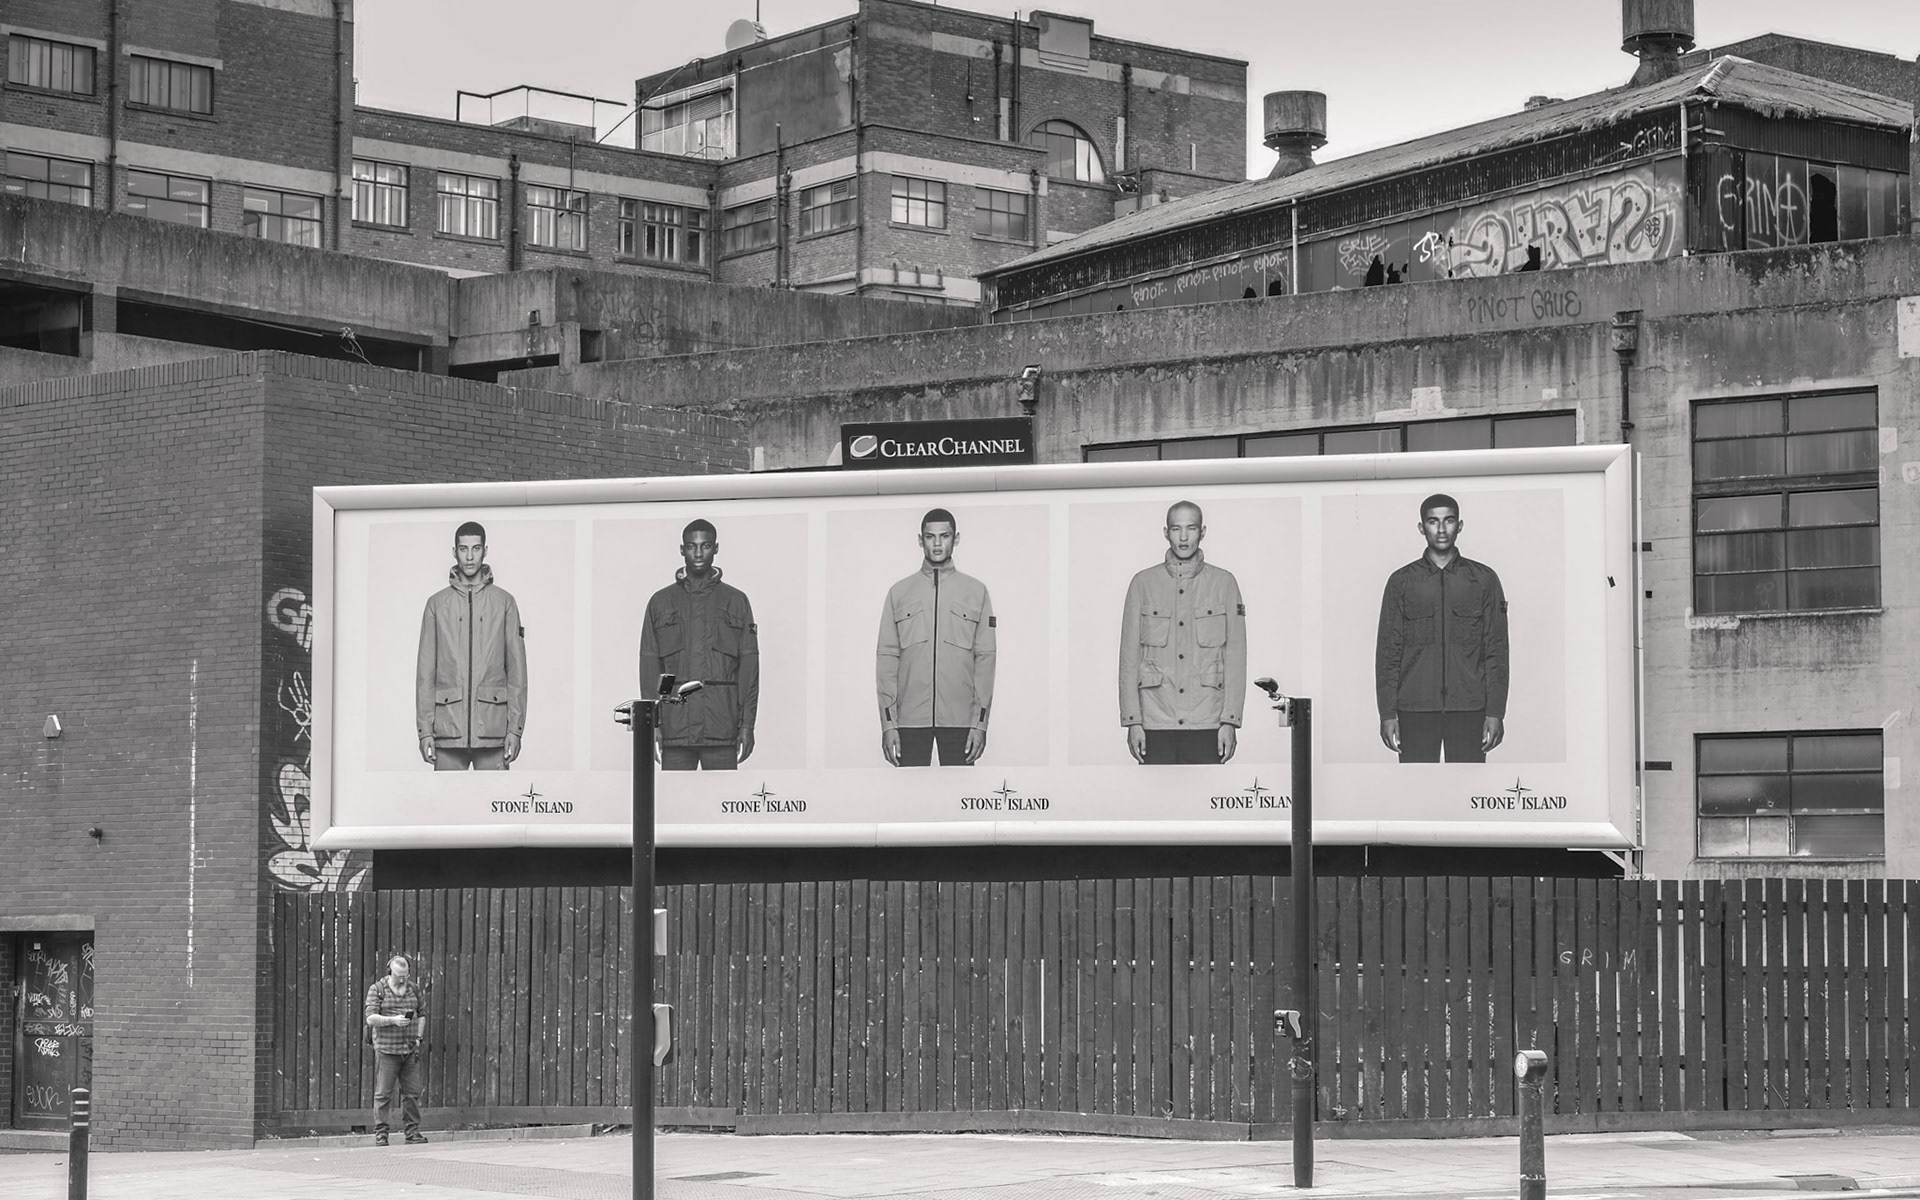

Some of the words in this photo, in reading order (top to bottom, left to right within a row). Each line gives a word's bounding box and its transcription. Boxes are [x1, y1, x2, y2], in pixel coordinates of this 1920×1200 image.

[1468, 296, 1525, 323] PINOT
[880, 437, 1025, 458] CLEARCHANNEL
[491, 800, 529, 813] STONE
[534, 801, 574, 813] ISLAND
[721, 800, 761, 813] STONE
[766, 800, 807, 812] ISLAND
[960, 797, 1002, 810] STONE
[1007, 798, 1050, 810] ISLAND
[1210, 796, 1253, 809] STONE
[1259, 796, 1292, 808] ISLAN
[1470, 796, 1515, 809] STONE
[1521, 796, 1567, 809] ISLAND
